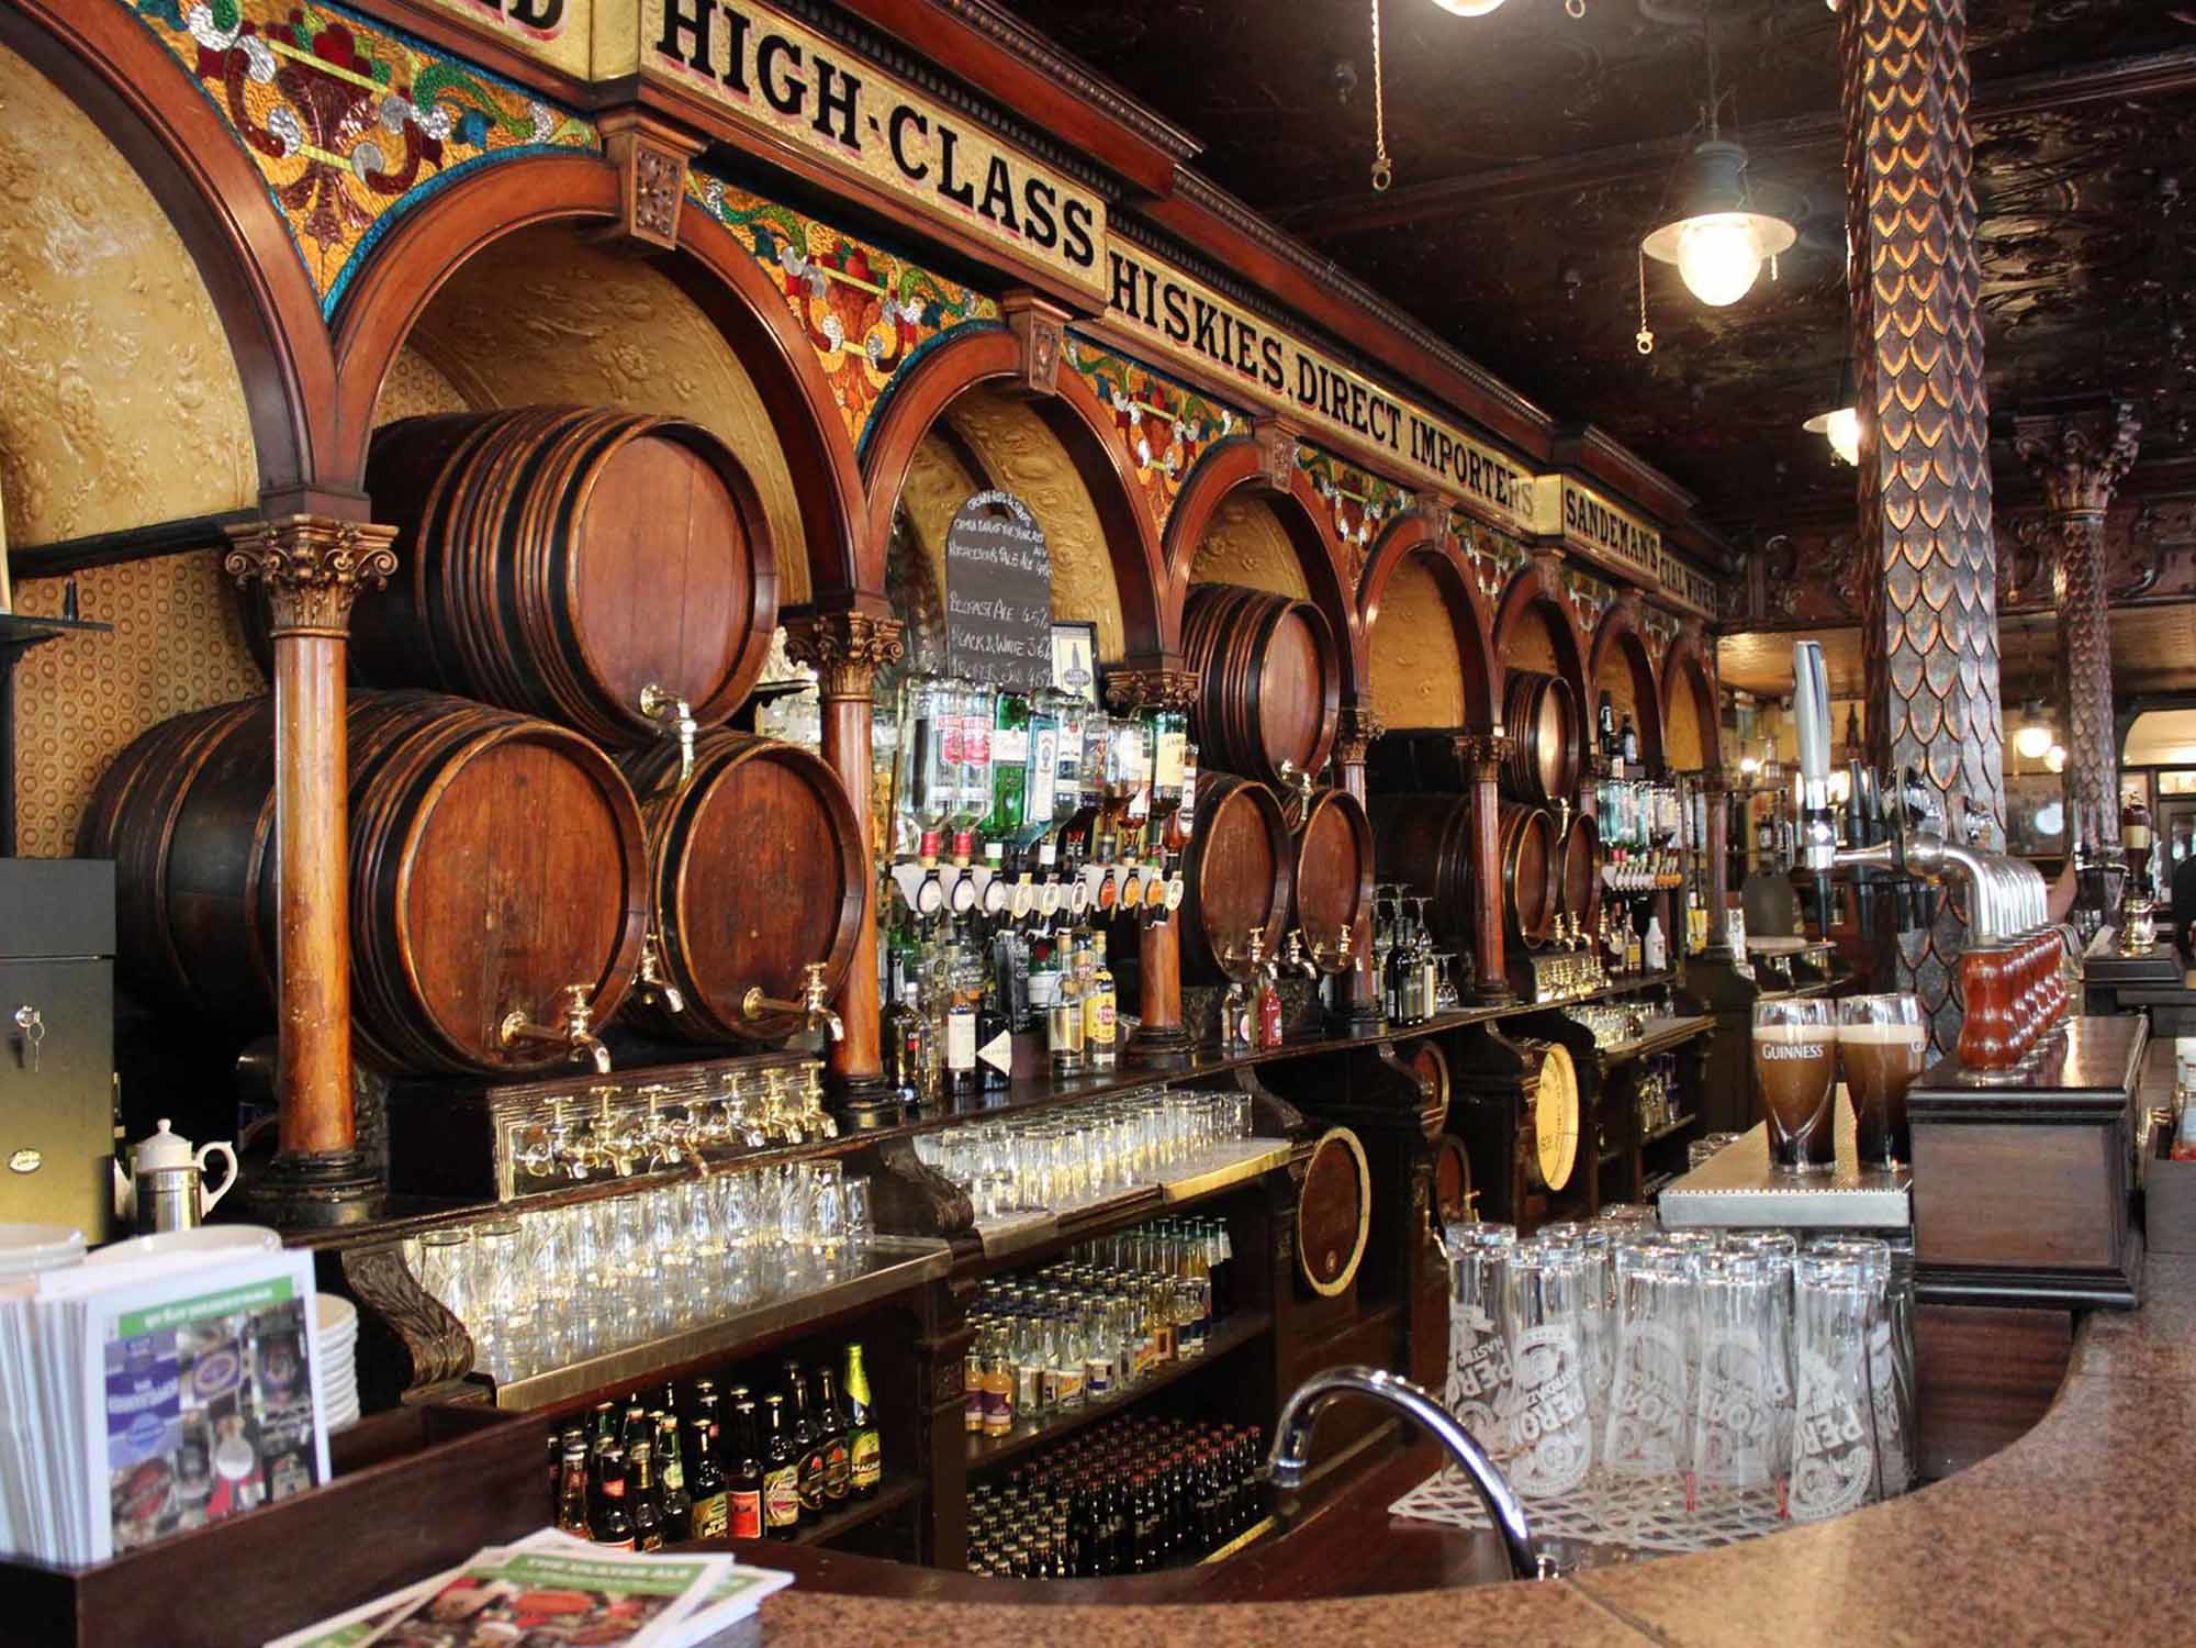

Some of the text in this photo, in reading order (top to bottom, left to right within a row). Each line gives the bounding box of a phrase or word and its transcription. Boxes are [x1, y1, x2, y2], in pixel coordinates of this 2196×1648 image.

[1296, 354, 1401, 449] DIRECT
[1409, 416, 1534, 517] IMPORTERS
[1762, 1043, 1824, 1060] GUINNESS
